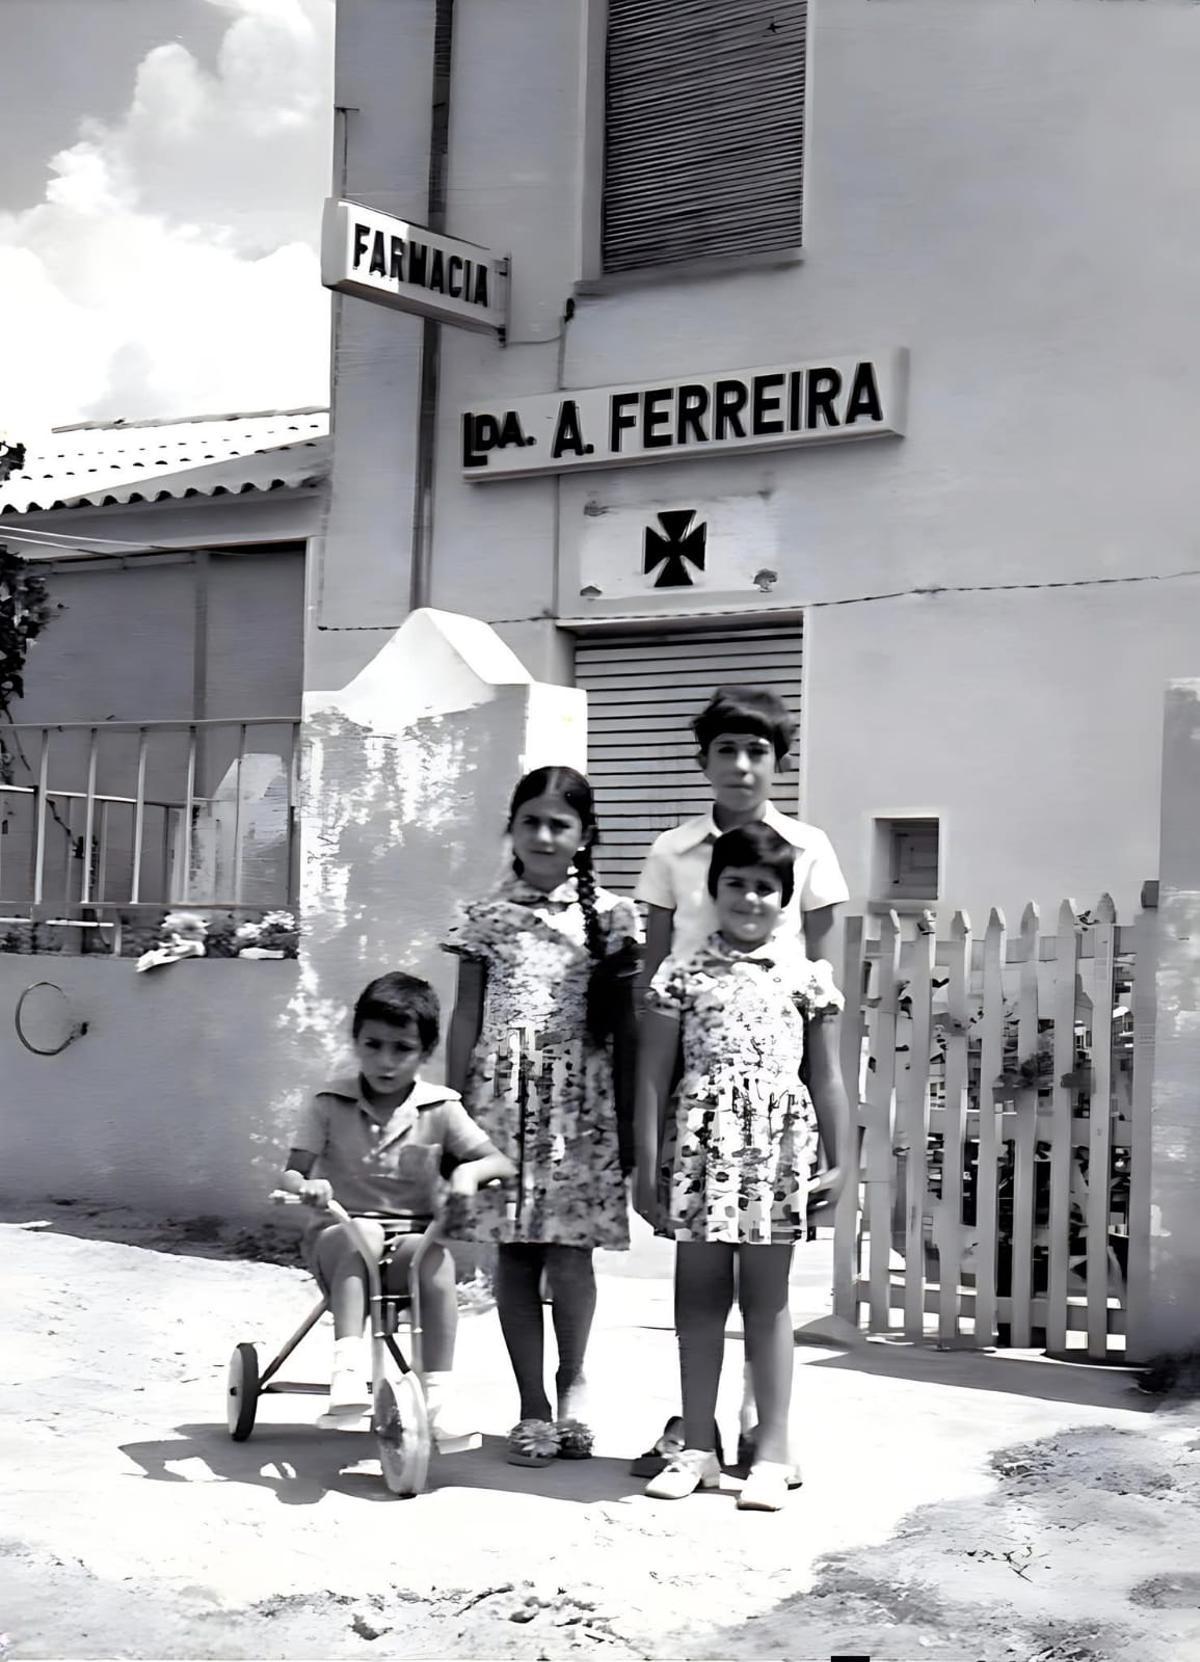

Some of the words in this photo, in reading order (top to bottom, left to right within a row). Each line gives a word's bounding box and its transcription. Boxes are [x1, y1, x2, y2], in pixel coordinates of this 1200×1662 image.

[353, 223, 488, 307] FARMACIA
[551, 400, 595, 458] A.
[610, 361, 884, 452] FERREIRA
